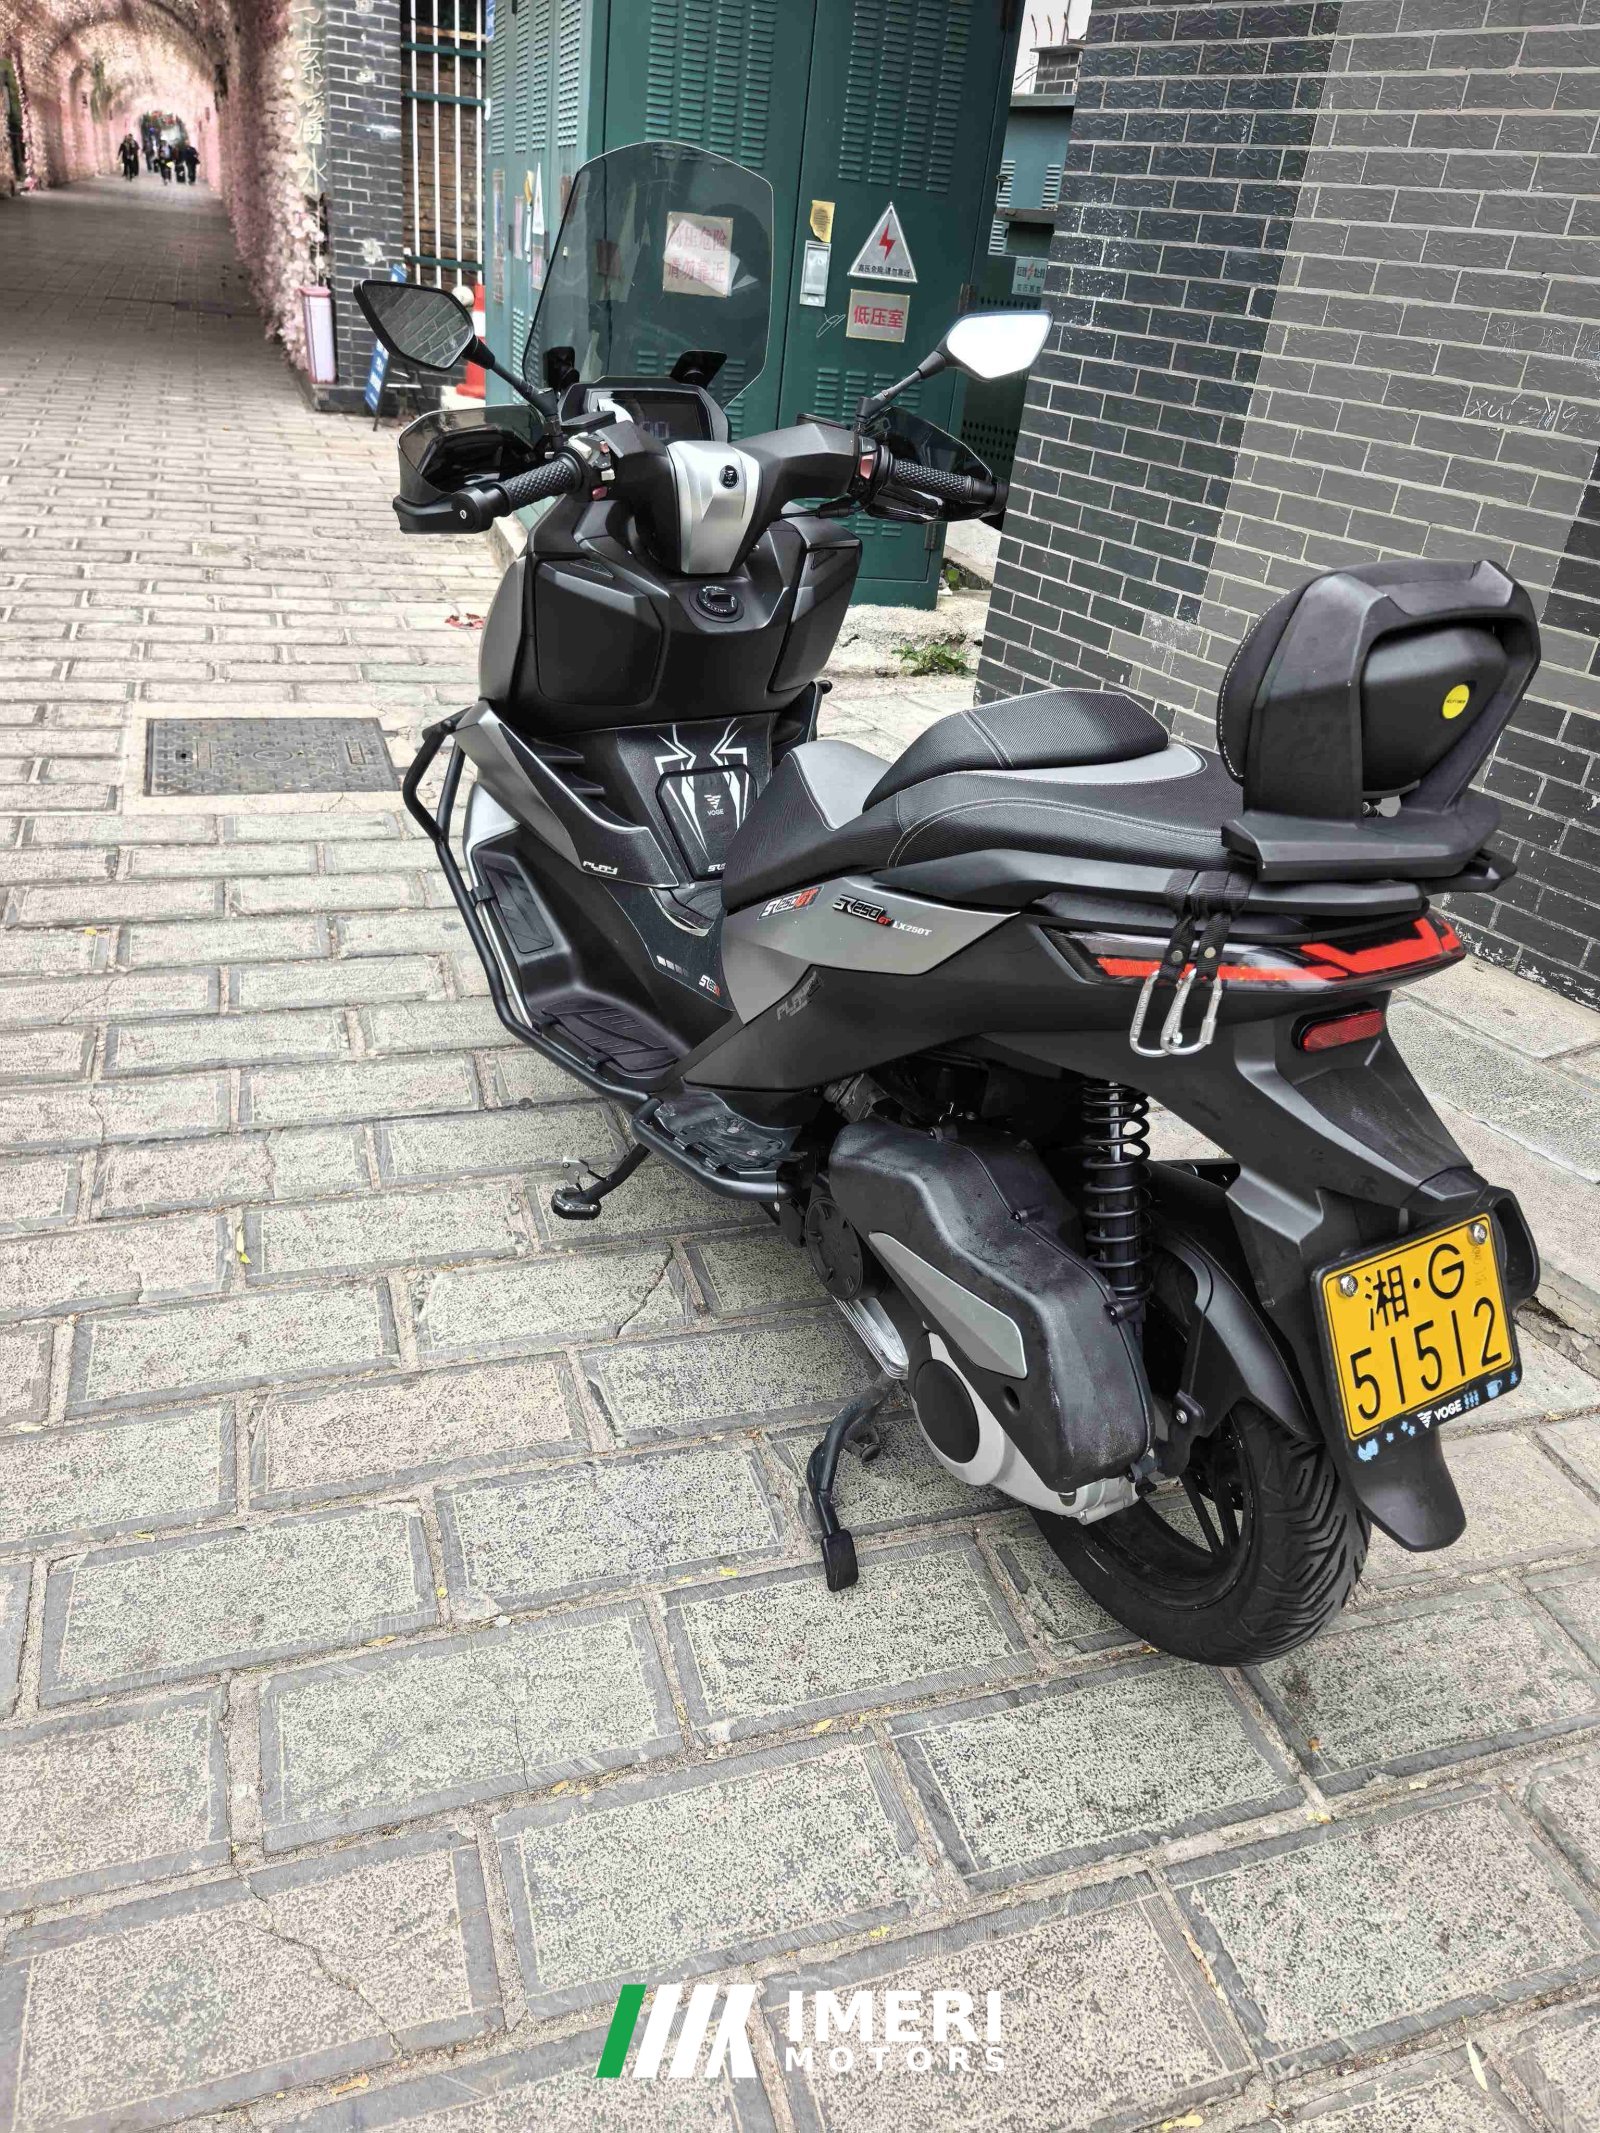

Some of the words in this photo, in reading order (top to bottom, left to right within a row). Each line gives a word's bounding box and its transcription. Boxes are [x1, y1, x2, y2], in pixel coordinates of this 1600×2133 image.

[853, 304, 905, 329] 低压室
[706, 808, 725, 817] VOGE
[892, 920, 932, 937] LX250T
[1350, 1296, 1502, 1421] 51512
[1433, 1399, 1463, 1421] VOGE
